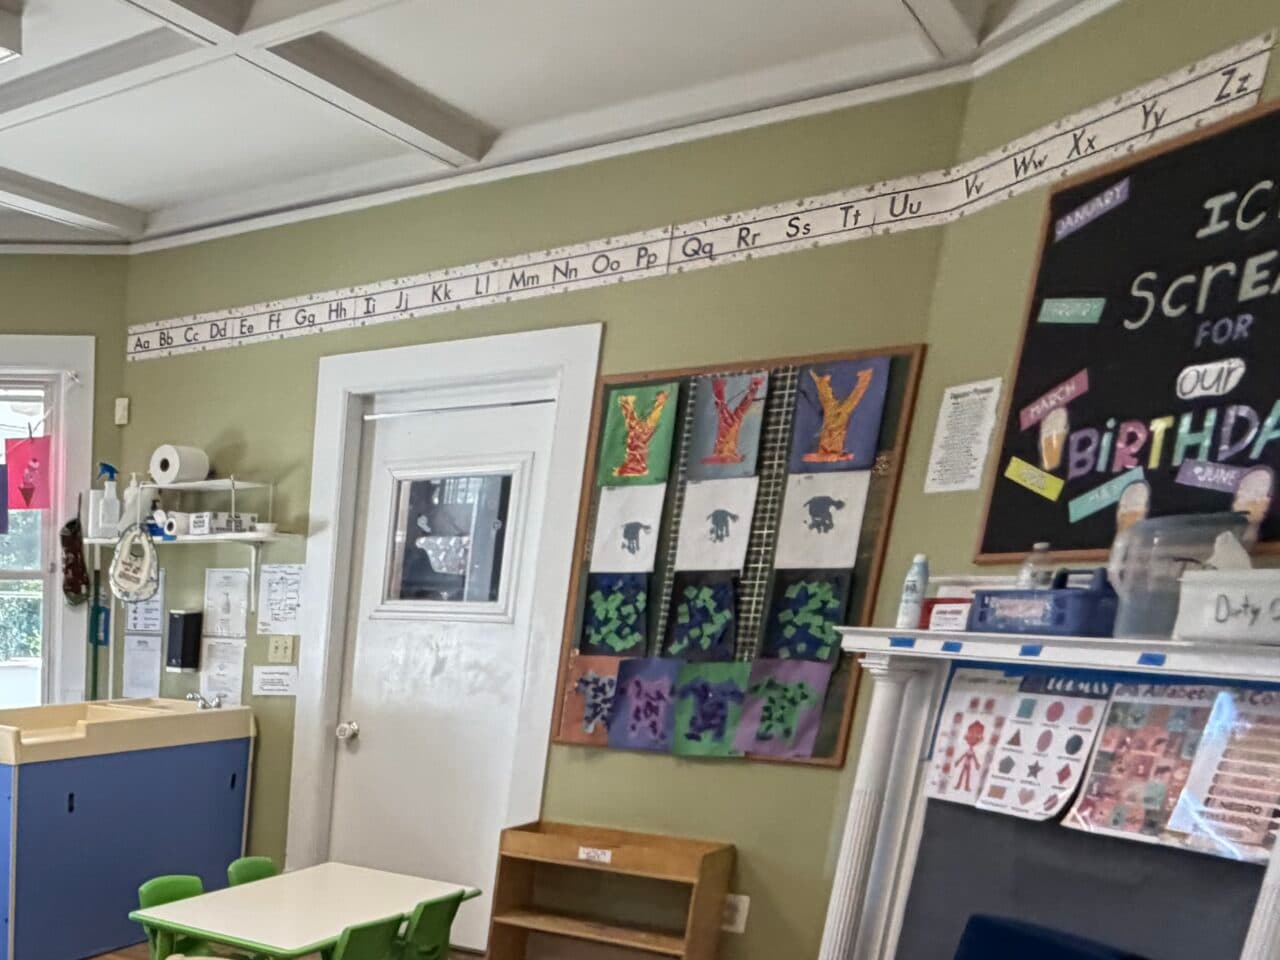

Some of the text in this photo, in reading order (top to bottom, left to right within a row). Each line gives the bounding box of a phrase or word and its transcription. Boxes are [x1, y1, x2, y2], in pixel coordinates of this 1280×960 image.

[134, 68, 1252, 351] Aa Bb Cc Dd Ee Ff Gg Hh Ii Jj Kk Ll Mm Nn Oo Pp Qq Rr Ss Tt Uu Vv Ww Xx Yy Zz
[1196, 180, 1280, 239] IC
[1195, 313, 1254, 348] FOR
[1195, 467, 1237, 486] JUNE
